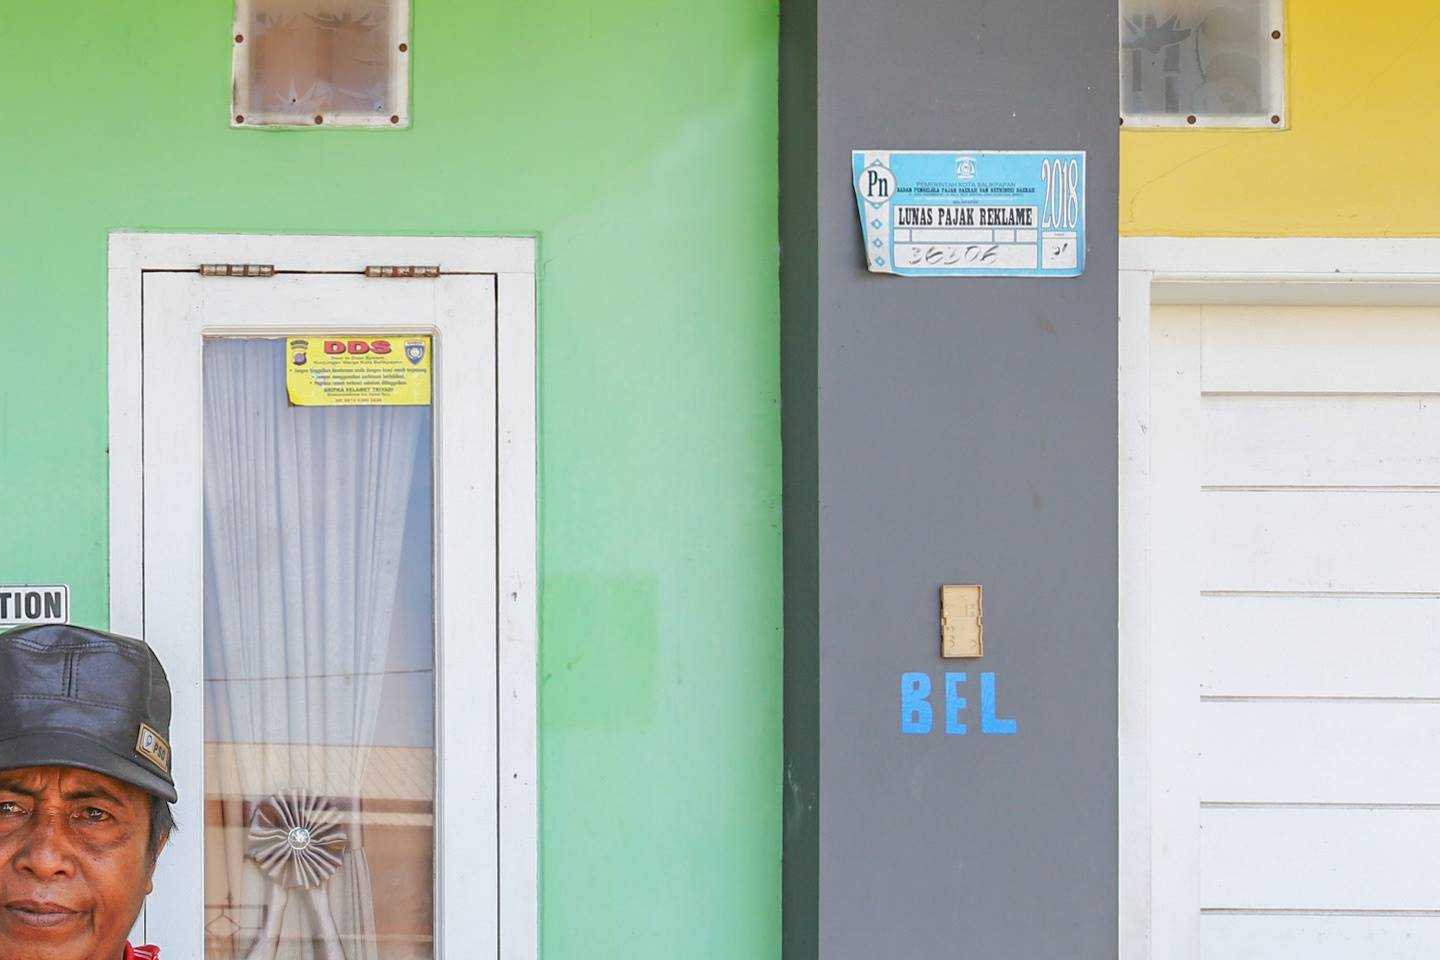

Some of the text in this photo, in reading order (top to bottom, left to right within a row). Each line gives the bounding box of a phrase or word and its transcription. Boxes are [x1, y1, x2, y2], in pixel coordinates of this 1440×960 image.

[868, 170, 889, 198] Pn
[1041, 159, 1079, 229] 2018
[898, 207, 1033, 226] LUNAS PAJAK REKLAME
[323, 340, 392, 355] DDS
[901, 671, 1017, 734] BEL
